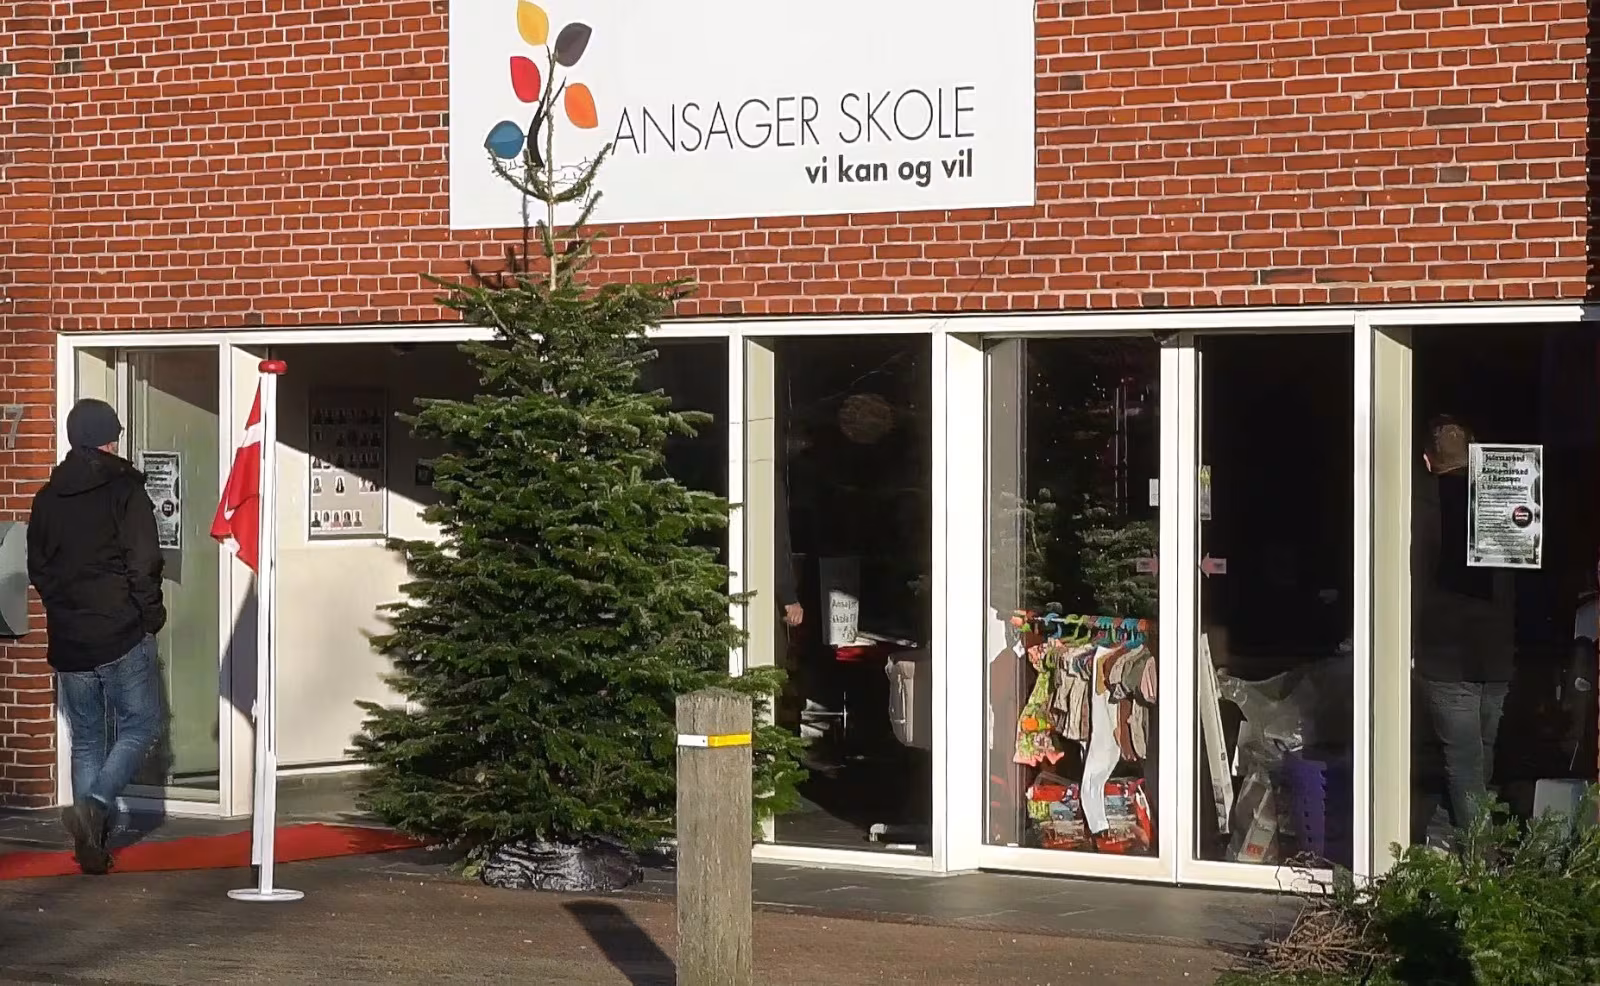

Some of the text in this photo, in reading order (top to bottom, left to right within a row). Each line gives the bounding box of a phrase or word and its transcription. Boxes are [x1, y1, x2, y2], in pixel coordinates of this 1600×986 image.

[611, 86, 975, 155] ANSAGER SKOLE
[805, 148, 973, 187] vi kan og vil
[6, 404, 24, 449] 7
